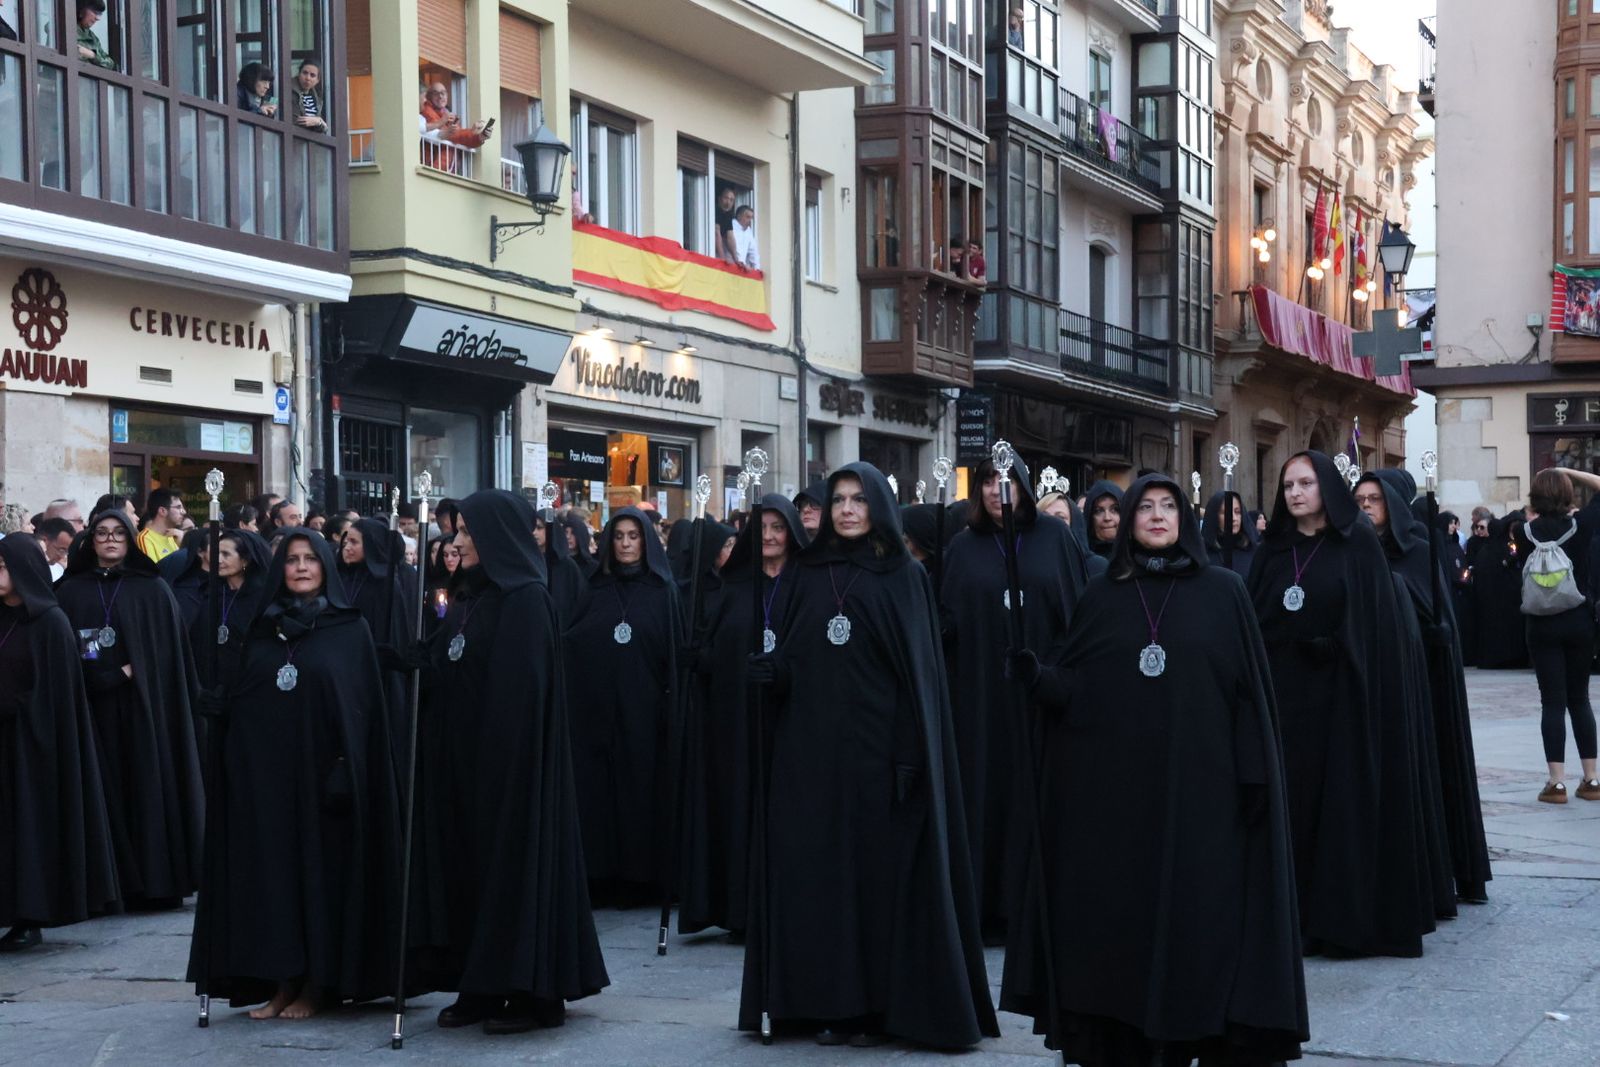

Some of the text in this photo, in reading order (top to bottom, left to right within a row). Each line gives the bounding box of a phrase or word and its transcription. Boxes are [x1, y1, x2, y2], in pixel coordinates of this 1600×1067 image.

[130, 307, 270, 352] CERVECERÍA
[437, 324, 501, 360] añada
[960, 408, 985, 417] VINOS
[569, 449, 580, 461] Pan
[581, 451, 605, 464] Artesano
